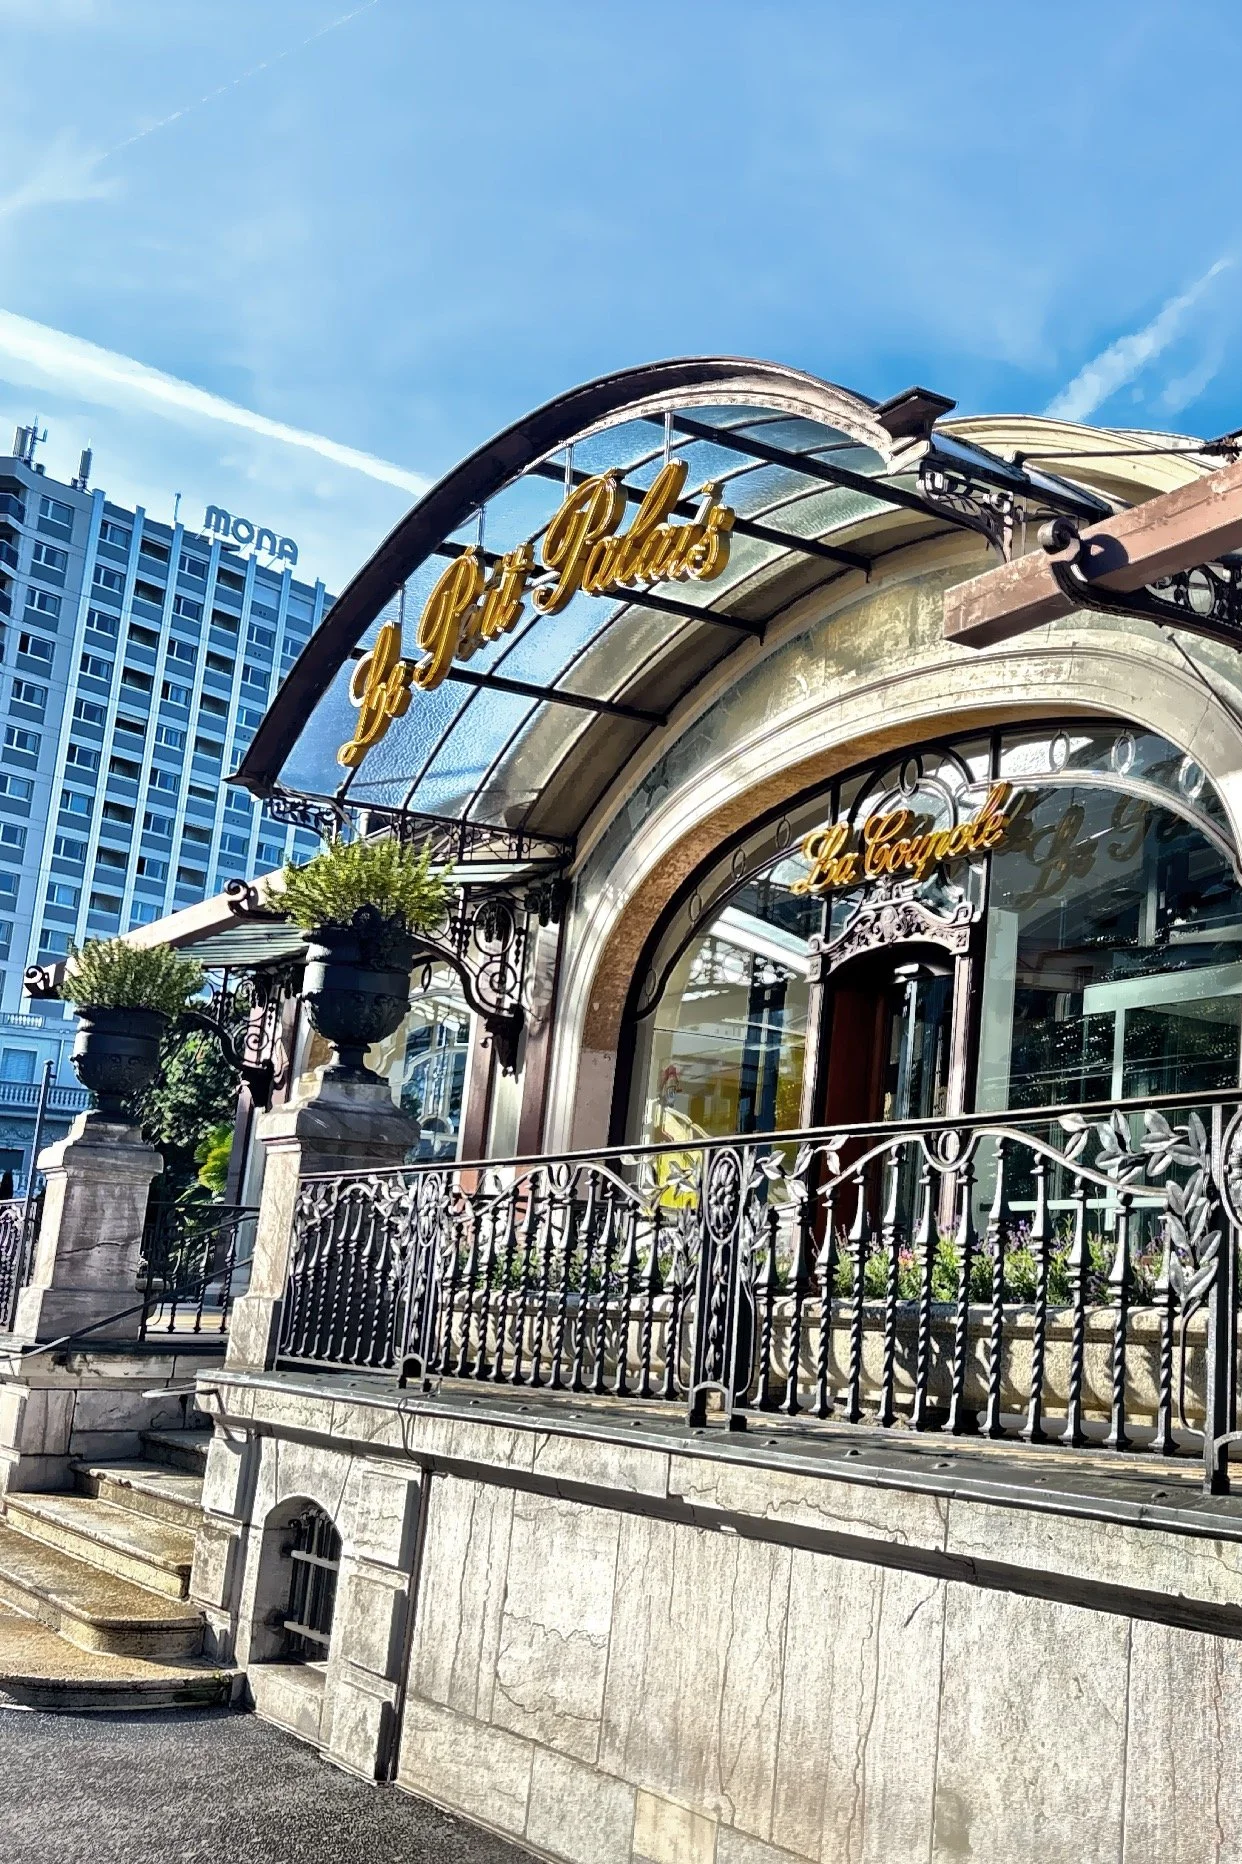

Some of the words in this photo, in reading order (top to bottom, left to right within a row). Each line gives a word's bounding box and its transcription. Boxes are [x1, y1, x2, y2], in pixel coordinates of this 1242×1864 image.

[337, 620, 412, 767] Le
[532, 457, 735, 615] Palais
[788, 821, 861, 896] La
